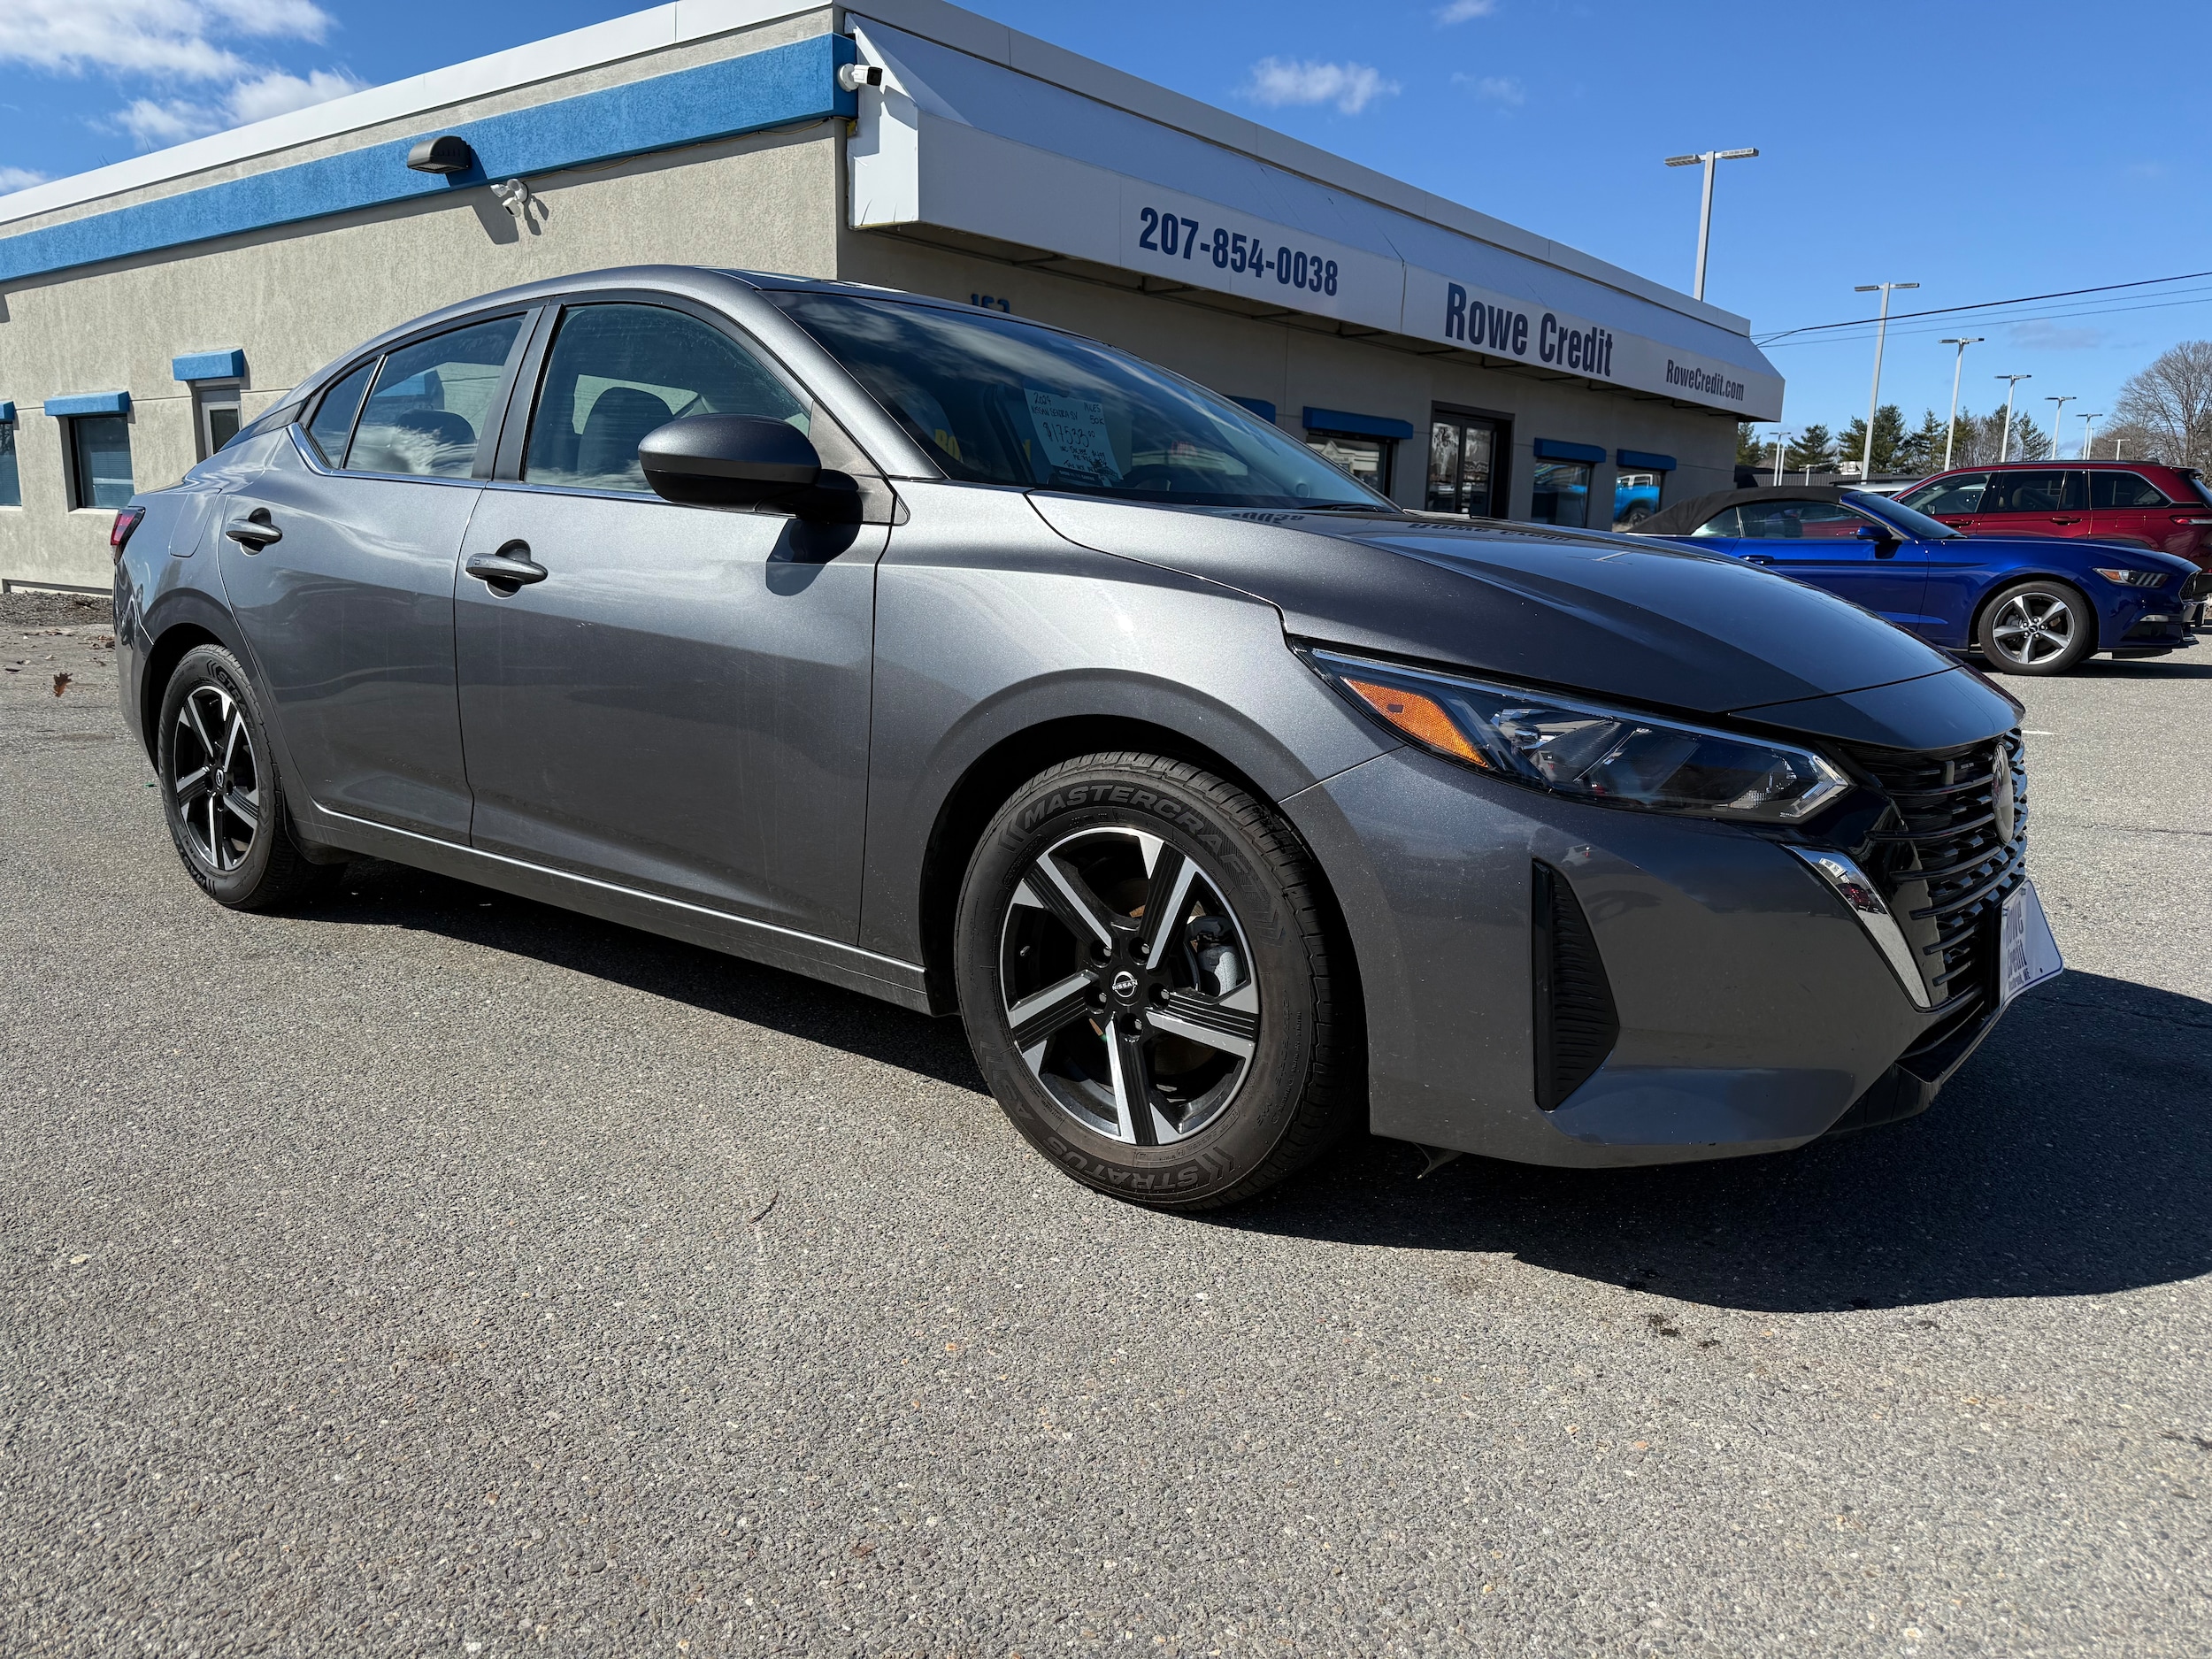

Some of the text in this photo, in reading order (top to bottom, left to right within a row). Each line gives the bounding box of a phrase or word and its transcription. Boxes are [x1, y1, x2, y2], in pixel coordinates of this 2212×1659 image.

[1139, 207, 1338, 296] 207-854-0038
[1445, 282, 1613, 377] Rowe Credit
[1666, 359, 1745, 401] RoweCredit.com
[1025, 785, 1270, 902] MASTERCRAFT
[1112, 979, 1138, 991] NISSAN
[1042, 1136, 1199, 1190] STRATUS
